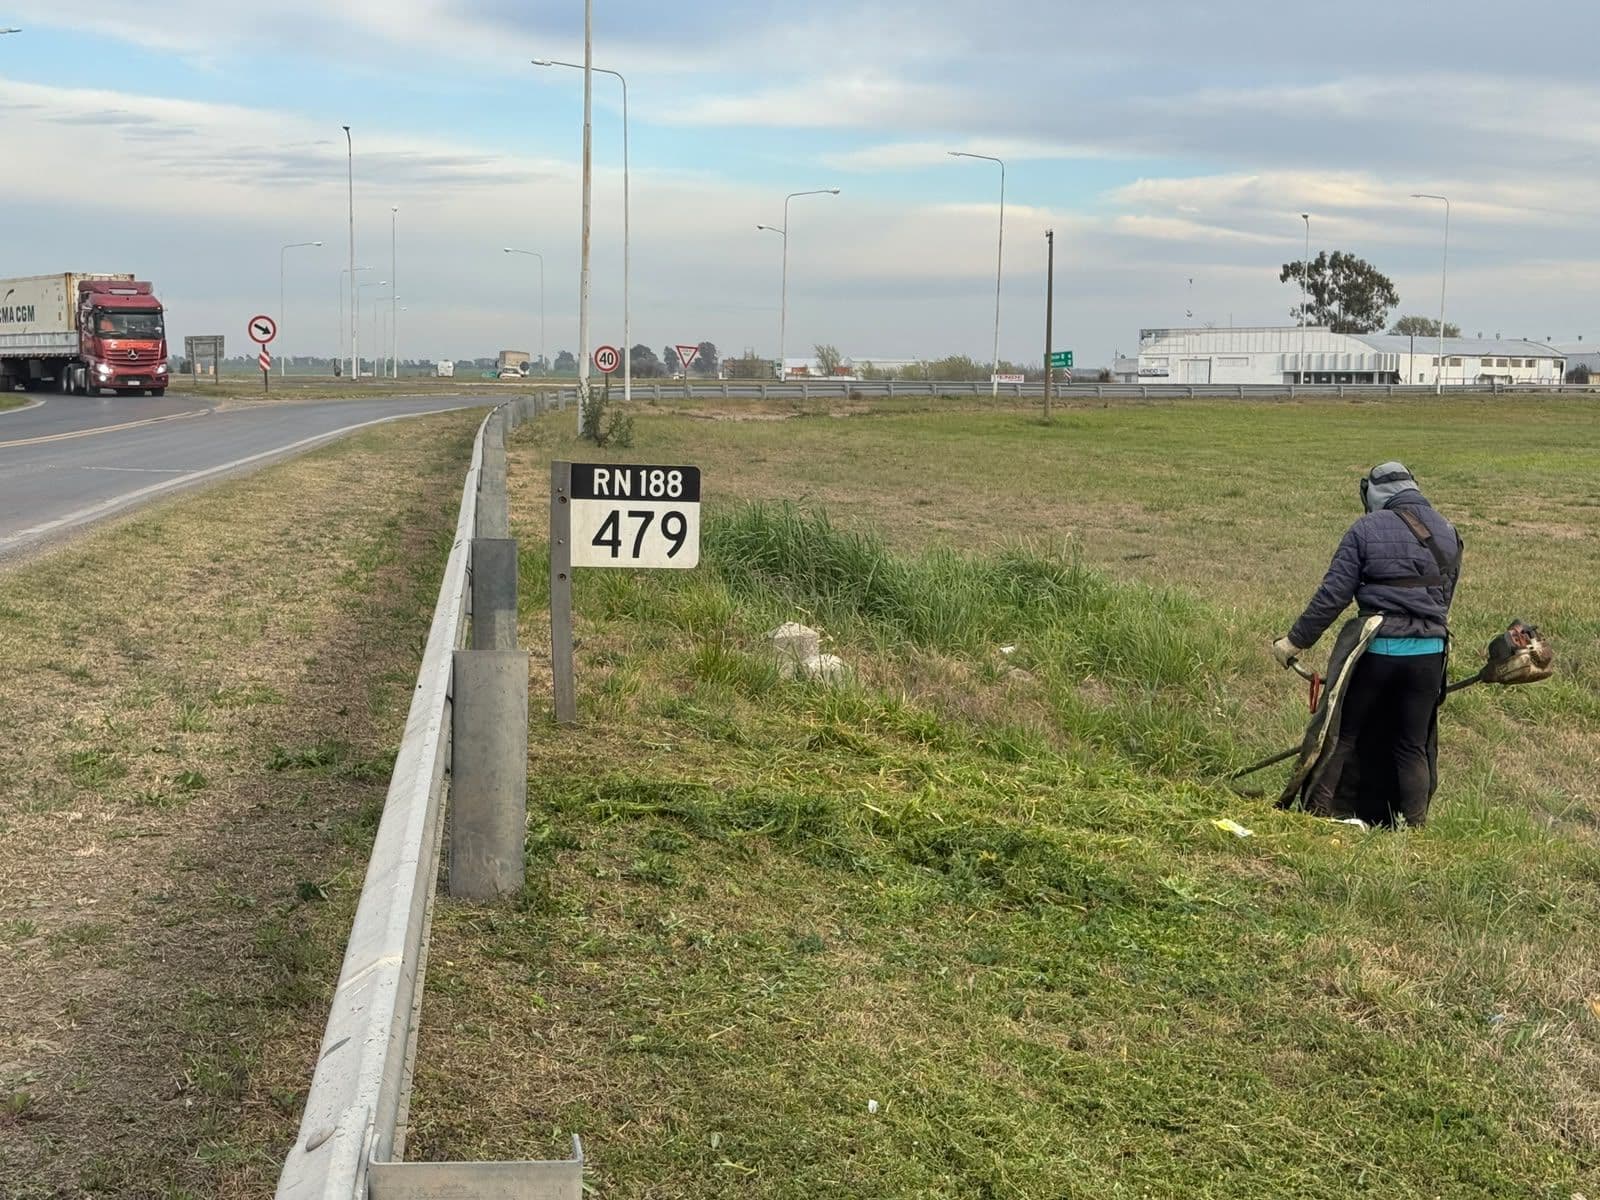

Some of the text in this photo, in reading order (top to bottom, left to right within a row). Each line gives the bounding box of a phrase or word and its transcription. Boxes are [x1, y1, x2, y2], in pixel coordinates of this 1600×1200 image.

[0, 304, 35, 323] MA CGM
[599, 351, 614, 366] 40
[593, 467, 683, 498] RN 188
[591, 509, 688, 559] 479
